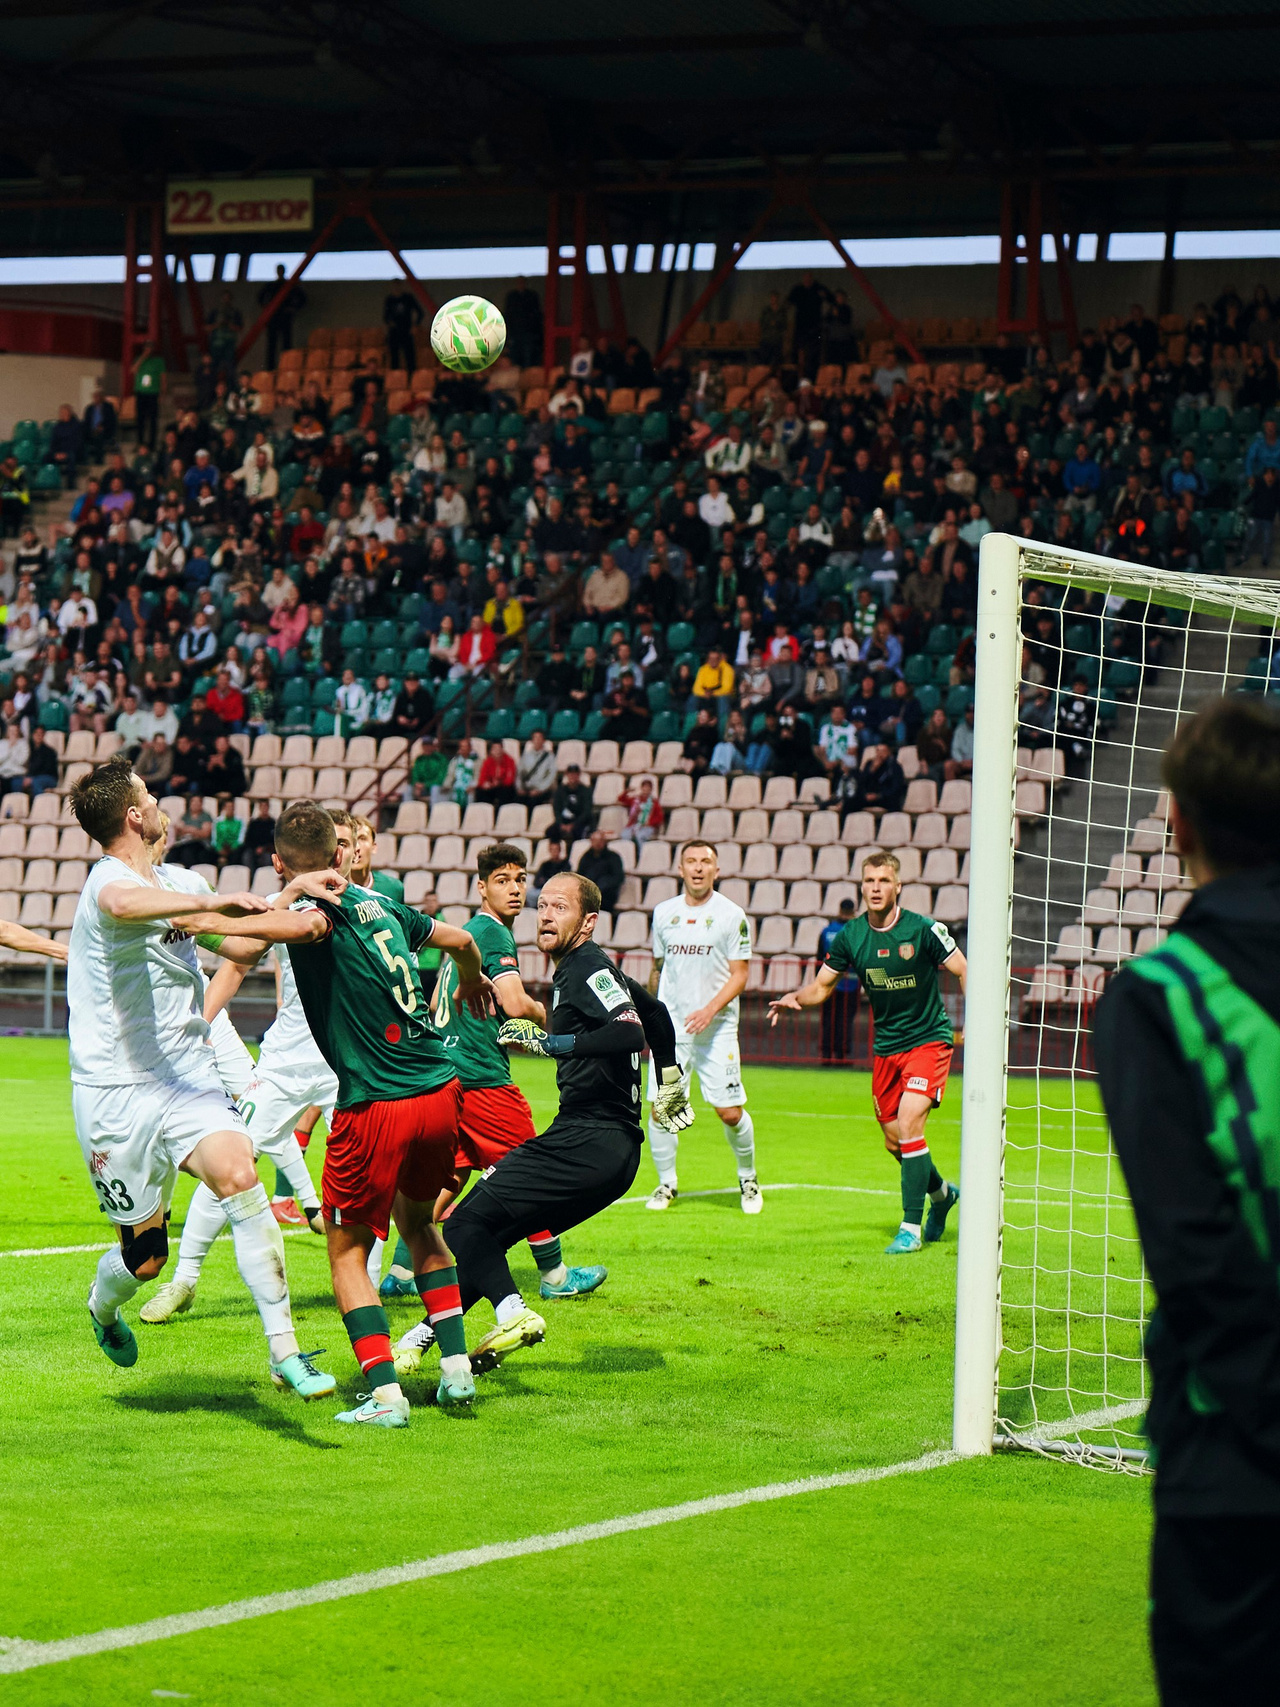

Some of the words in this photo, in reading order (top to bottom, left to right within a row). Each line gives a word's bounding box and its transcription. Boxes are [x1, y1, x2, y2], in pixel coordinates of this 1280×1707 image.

[170, 190, 213, 224] 22
[218, 200, 309, 223] СЕКТОР
[667, 944, 714, 955] FONBET
[373, 929, 417, 1014] 5
[884, 978, 914, 989] Westa
[96, 1179, 135, 1213] 33
